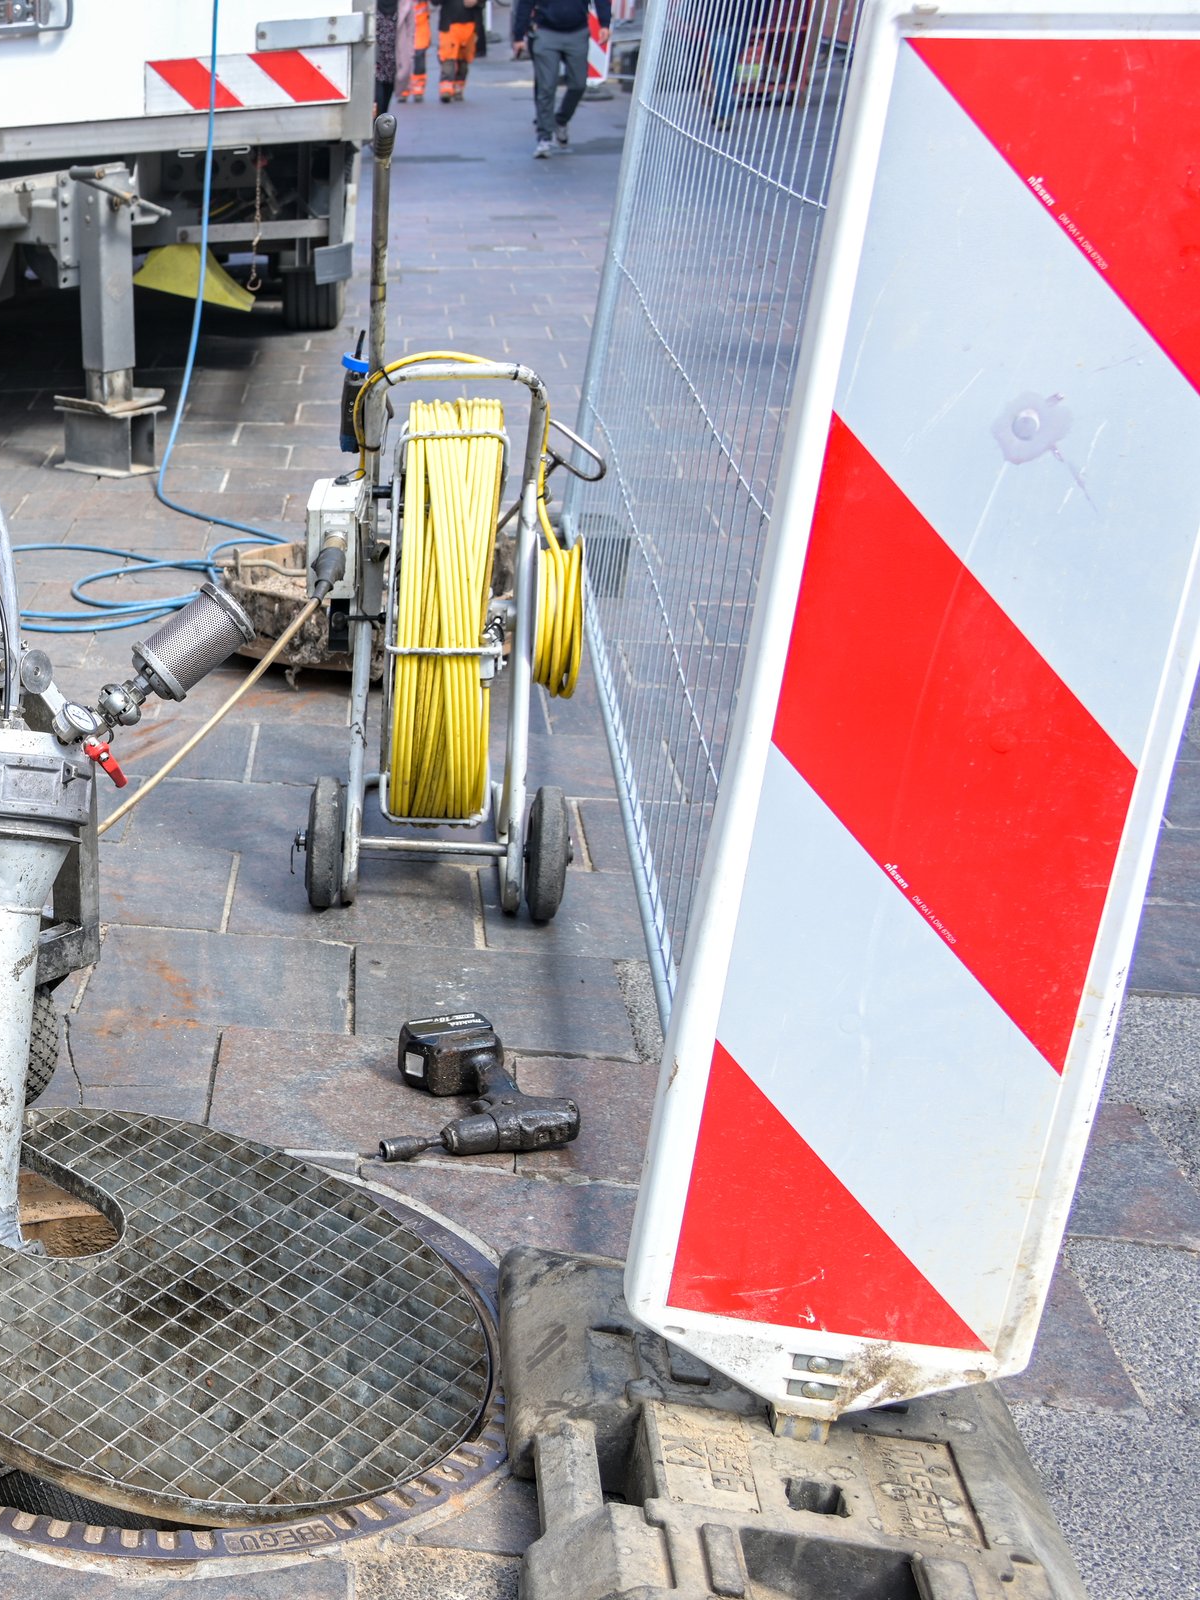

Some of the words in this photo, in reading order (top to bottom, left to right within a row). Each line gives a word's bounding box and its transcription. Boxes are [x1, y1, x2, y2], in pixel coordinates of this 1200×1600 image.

[1027, 176, 1055, 206] nissen
[884, 863, 909, 889] nissen
[448, 1018, 485, 1028] makita
[240, 1525, 321, 1551] BEGU
